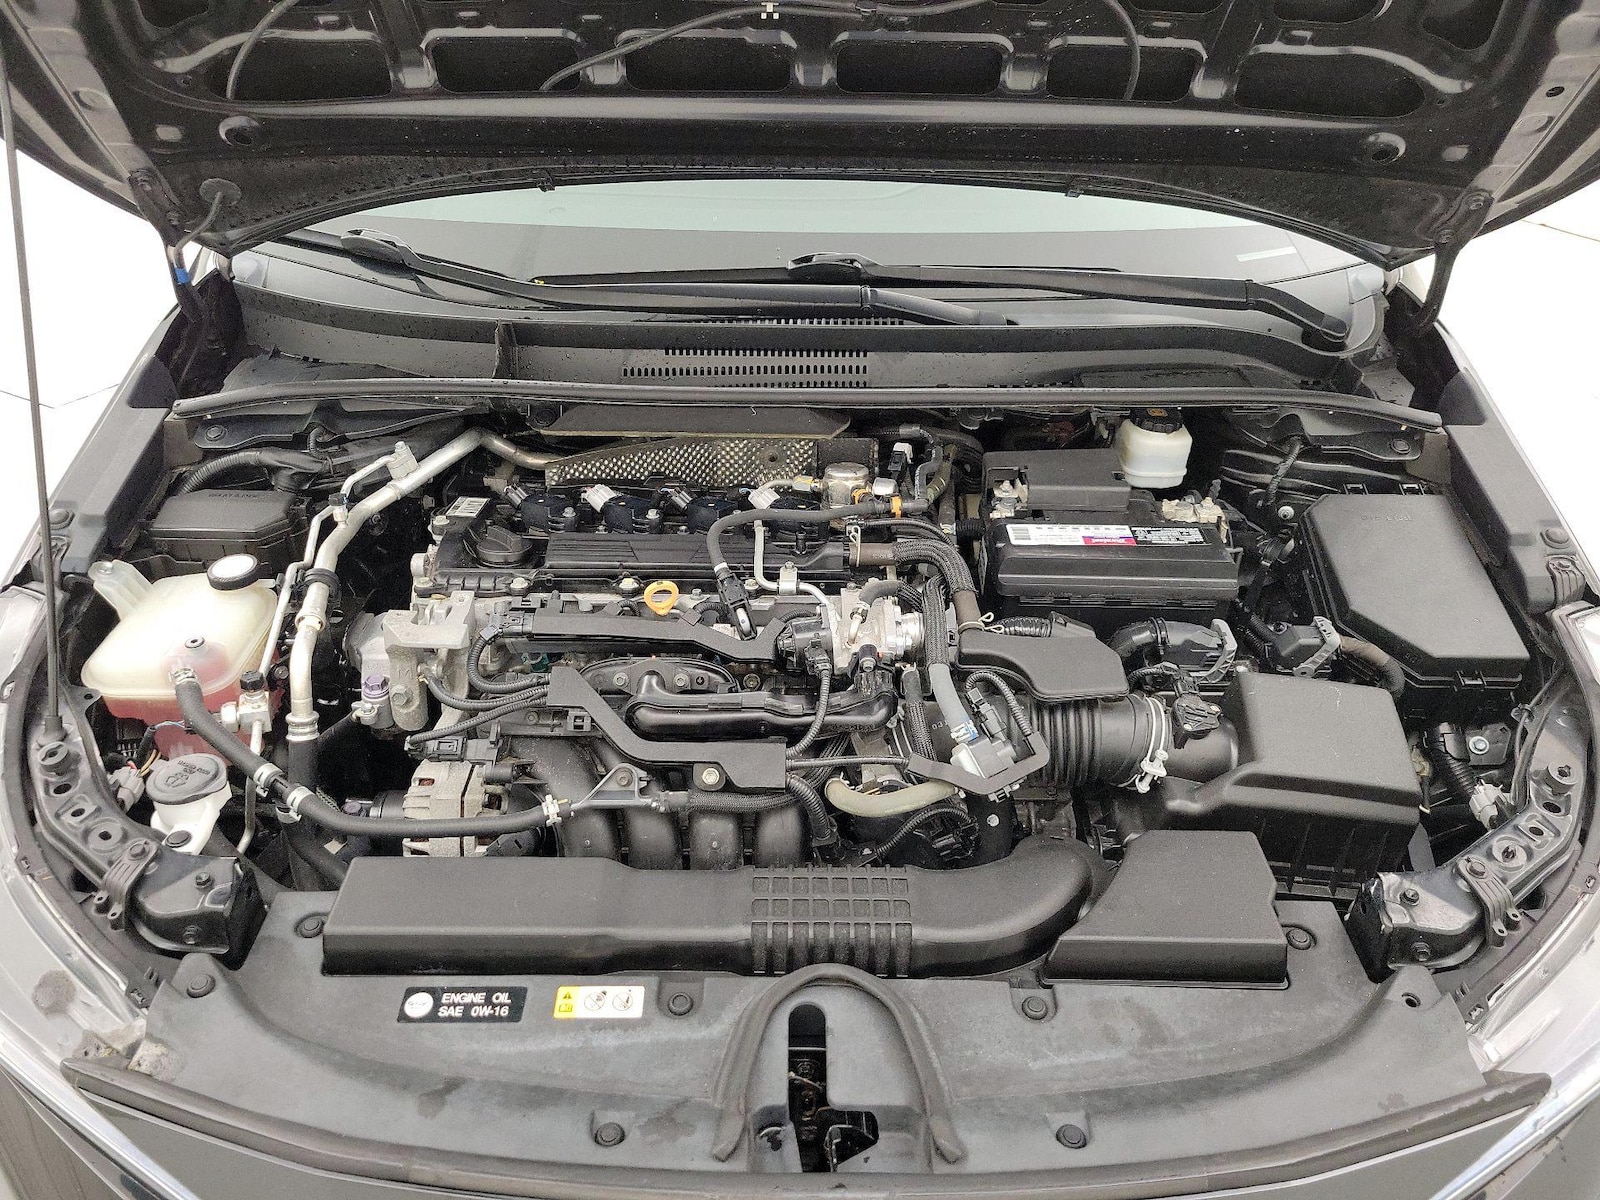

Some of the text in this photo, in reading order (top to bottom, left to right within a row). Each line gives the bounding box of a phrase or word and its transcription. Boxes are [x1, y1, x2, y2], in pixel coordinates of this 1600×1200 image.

[441, 992, 511, 1004] ENGINE OIL
[437, 1005, 464, 1017] SAE
[470, 1005, 509, 1017] 0W-16
